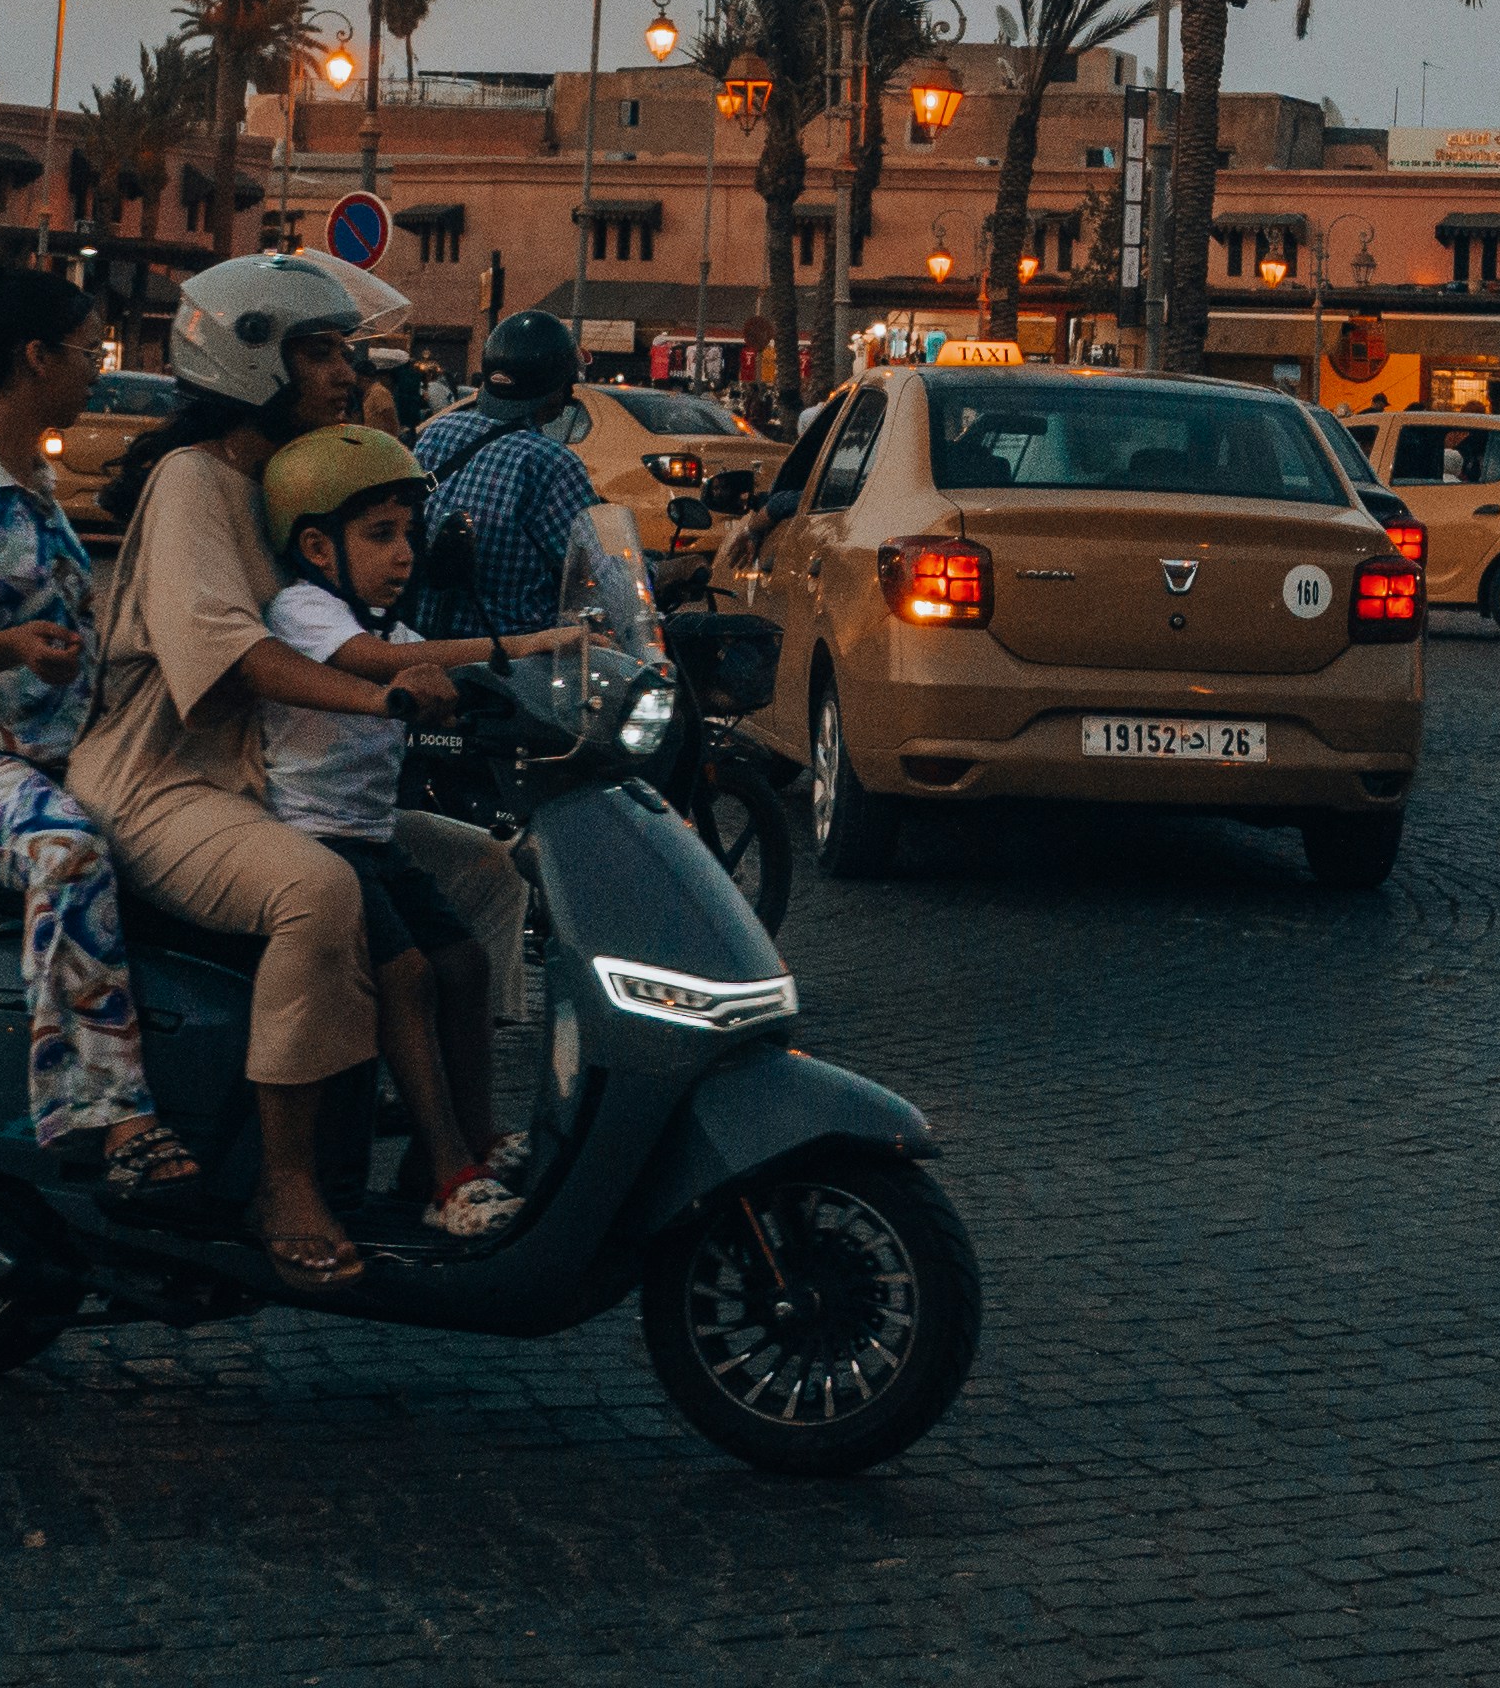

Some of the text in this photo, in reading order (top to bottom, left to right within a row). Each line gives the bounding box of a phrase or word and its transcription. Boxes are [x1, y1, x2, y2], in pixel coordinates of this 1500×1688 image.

[957, 346, 1010, 363] TAXI
[1297, 579, 1320, 606] 160
[420, 734, 463, 747] DOCKER
[1103, 724, 1177, 753] 19152
[1221, 728, 1251, 756] 26
